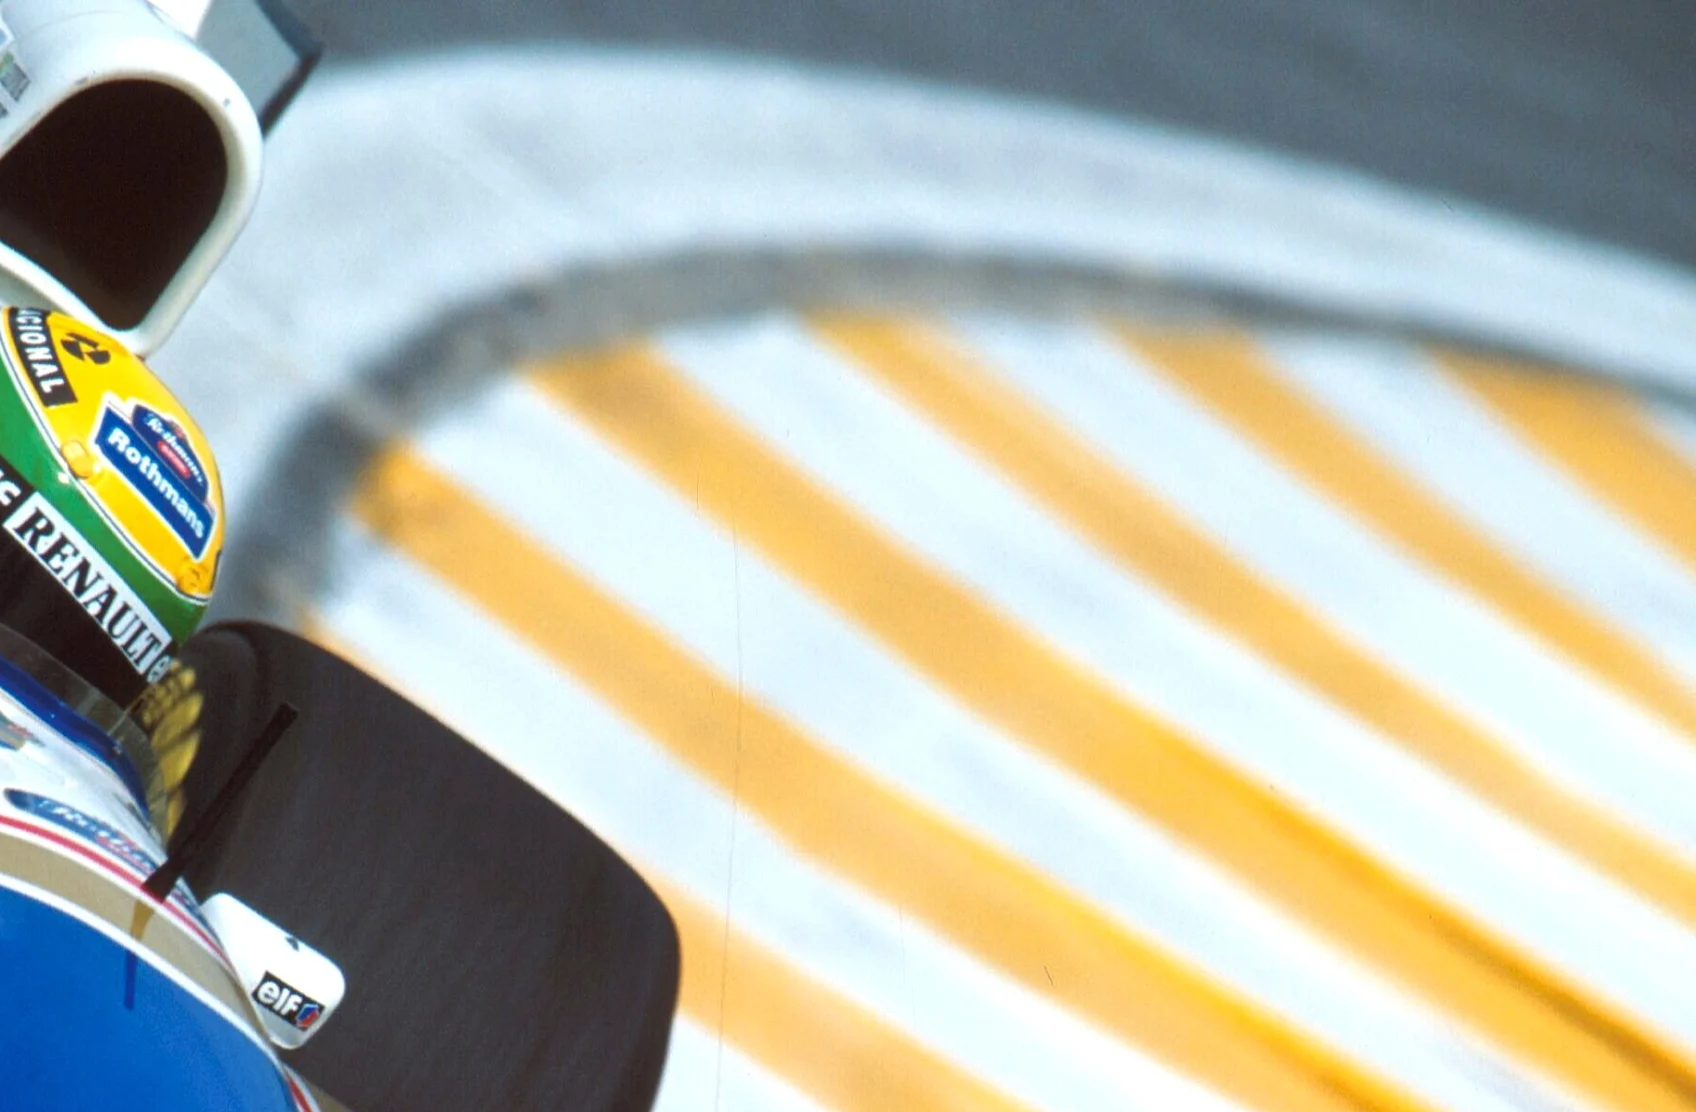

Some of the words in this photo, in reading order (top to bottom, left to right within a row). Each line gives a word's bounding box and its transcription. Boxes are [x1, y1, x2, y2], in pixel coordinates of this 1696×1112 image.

[17, 308, 64, 394] CIONAL
[107, 426, 205, 540] Rothmans
[13, 507, 161, 669] RENAULT
[257, 981, 302, 1015] elf
